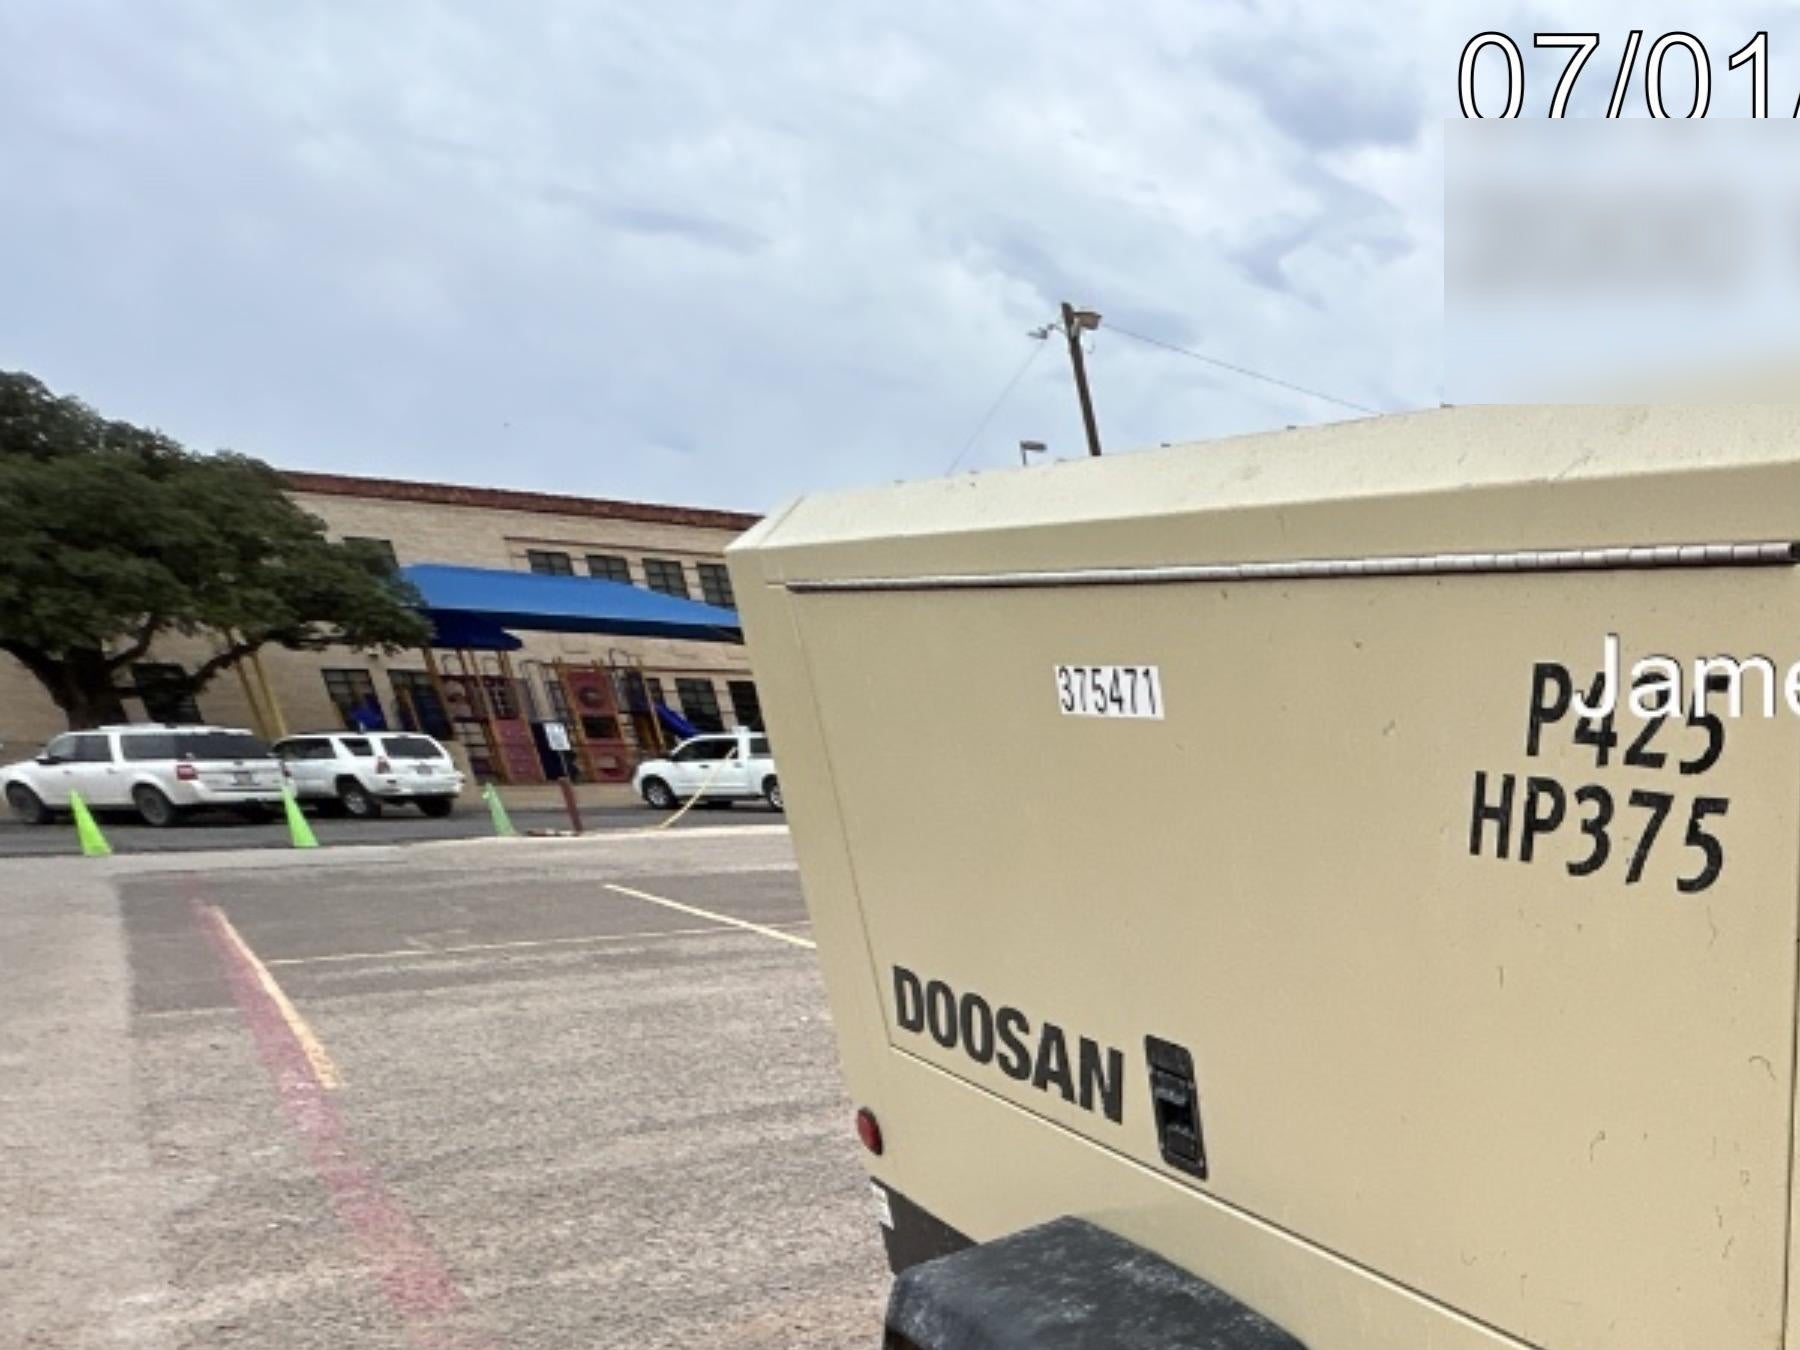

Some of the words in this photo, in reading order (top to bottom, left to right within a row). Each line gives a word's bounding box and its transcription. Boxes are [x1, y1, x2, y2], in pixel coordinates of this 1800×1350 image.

[1058, 665, 1156, 715] 375471
[1526, 660, 1726, 776] P425
[1468, 769, 1730, 894] HP375
[892, 964, 1125, 1126] DOOSAN
